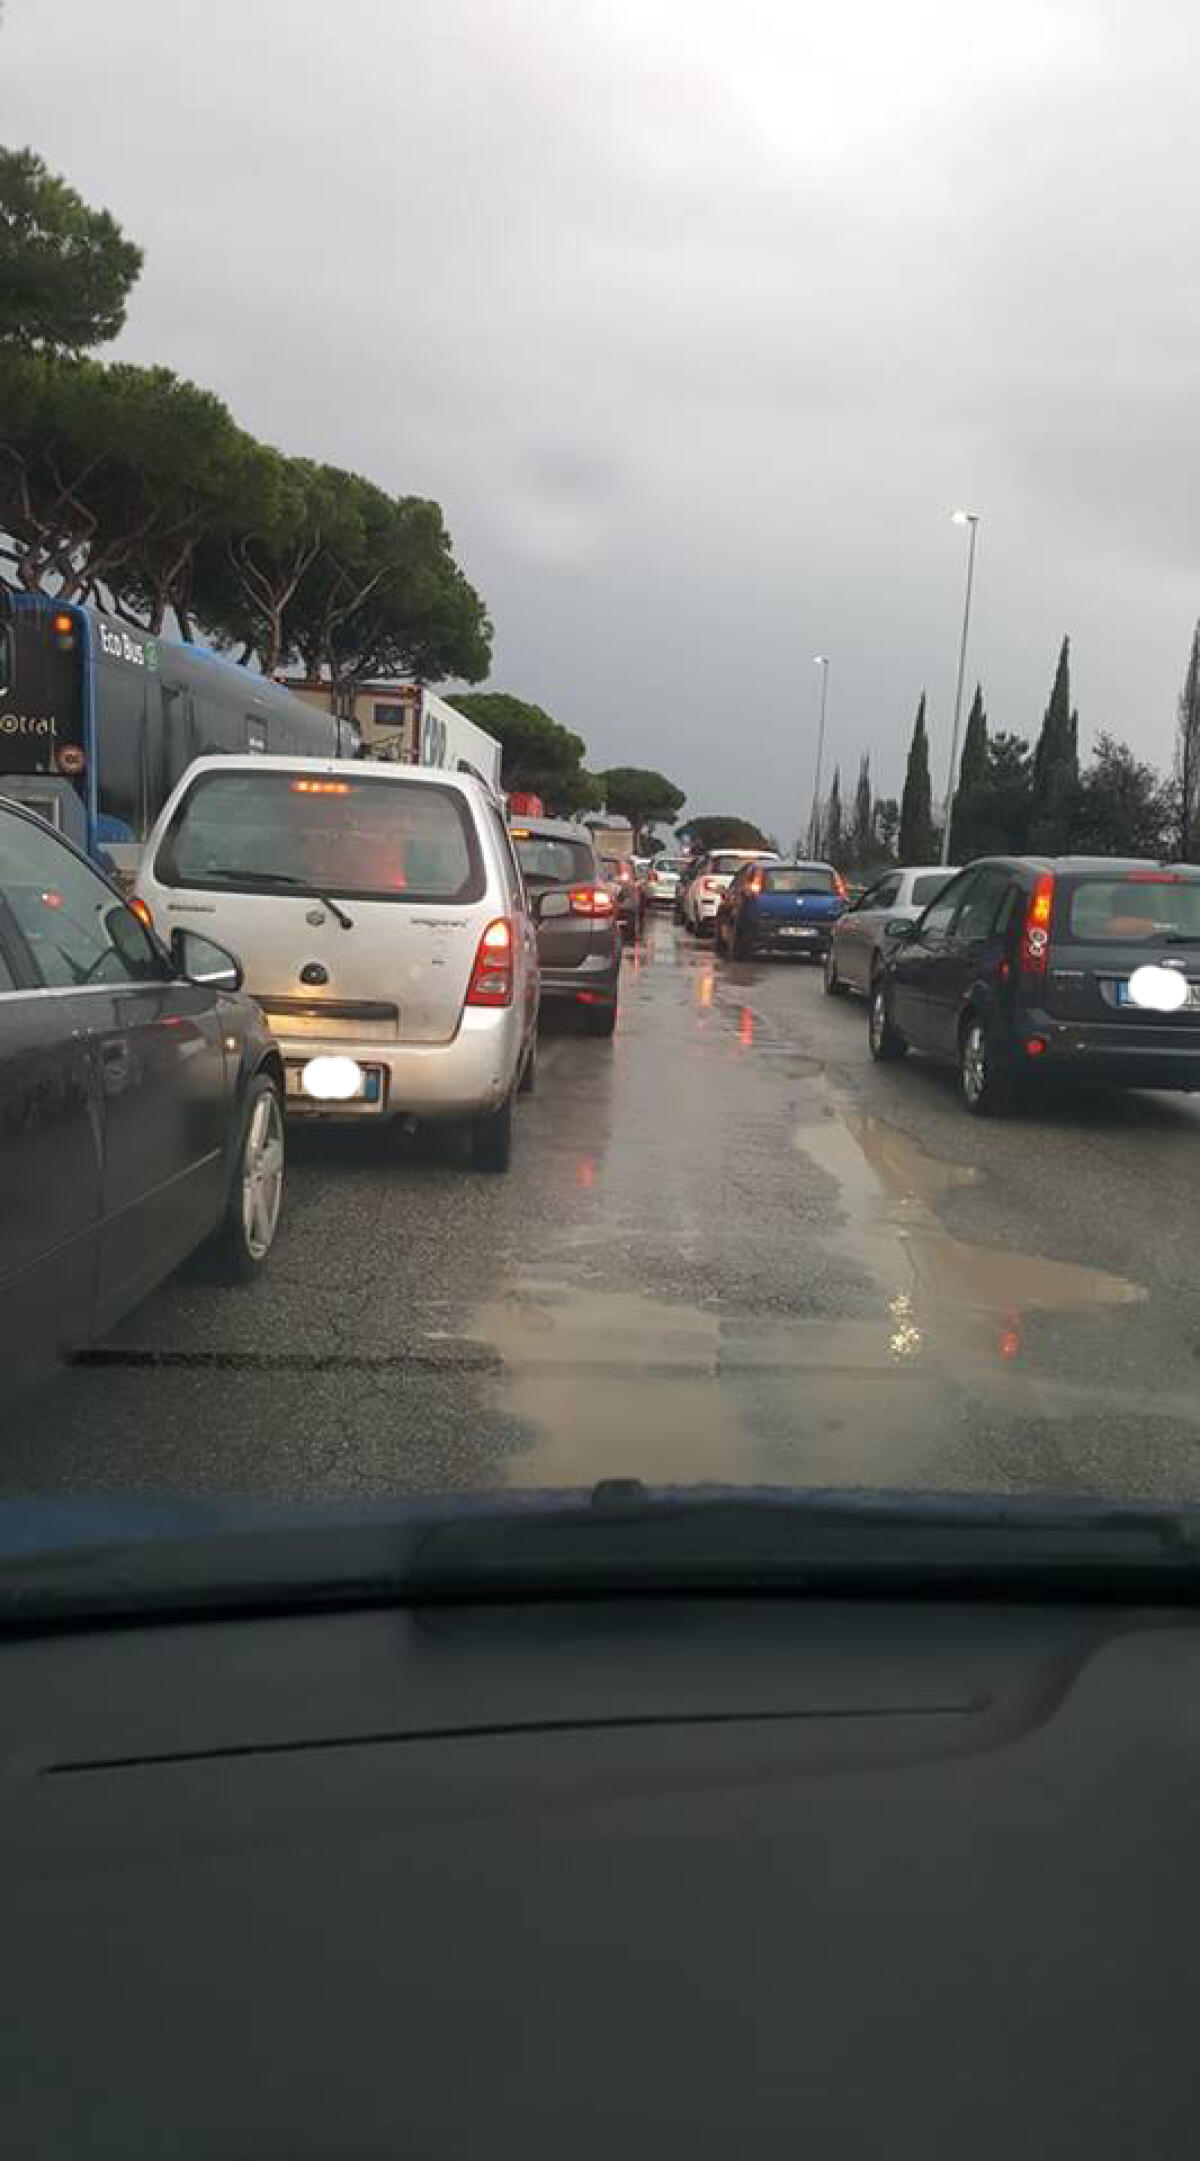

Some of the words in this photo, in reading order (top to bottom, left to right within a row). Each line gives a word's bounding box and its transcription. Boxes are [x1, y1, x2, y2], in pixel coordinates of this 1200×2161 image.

[99, 623, 121, 657] Eco
[121, 632, 145, 665] Bus
[0, 713, 57, 736] otral
